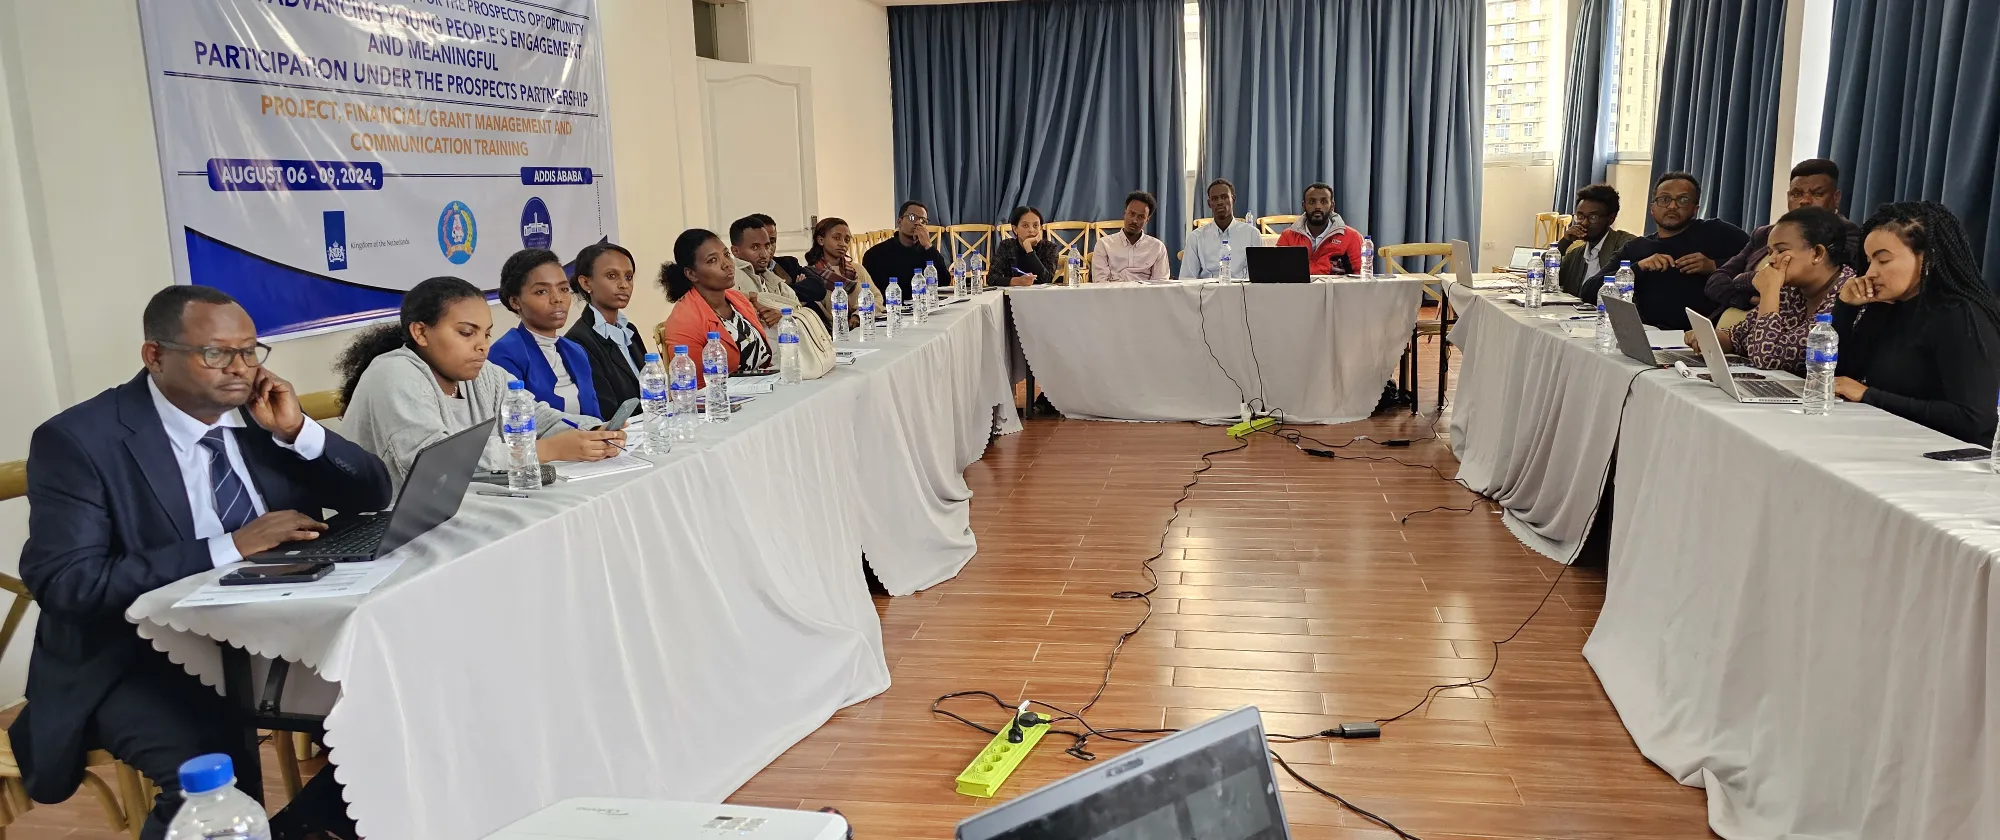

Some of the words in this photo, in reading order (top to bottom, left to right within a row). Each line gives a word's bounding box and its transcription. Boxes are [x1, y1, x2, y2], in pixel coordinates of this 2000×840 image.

[266, 0, 383, 24] VANCING
[388, 5, 443, 33] YOUNG
[446, 17, 508, 46] PEOPLE'S
[511, 31, 582, 60] ENGAGEMENT
[468, 0, 526, 24] PROSPECTS
[528, 12, 584, 36] OPPORTUNITY
[368, 33, 403, 57] AND
[408, 39, 499, 70] MEANINGFUL
[194, 40, 348, 82] PARTICIPATION
[353, 62, 412, 88] UNDER
[415, 70, 443, 92] THE
[447, 74, 517, 100] PROSPECTS
[520, 85, 588, 107] PARTNERSHIP
[261, 94, 342, 123] PROJECT,
[474, 113, 551, 134] MANAGEMENT
[554, 120, 572, 136] AND
[351, 132, 472, 155] COMMUNICATION
[474, 139, 529, 156] TRAINING
[222, 166, 283, 184] AUGUST
[286, 166, 307, 184] 06
[534, 170, 556, 183] ADDIS
[557, 170, 583, 183] ABABA
[350, 241, 372, 250] Kingdom
